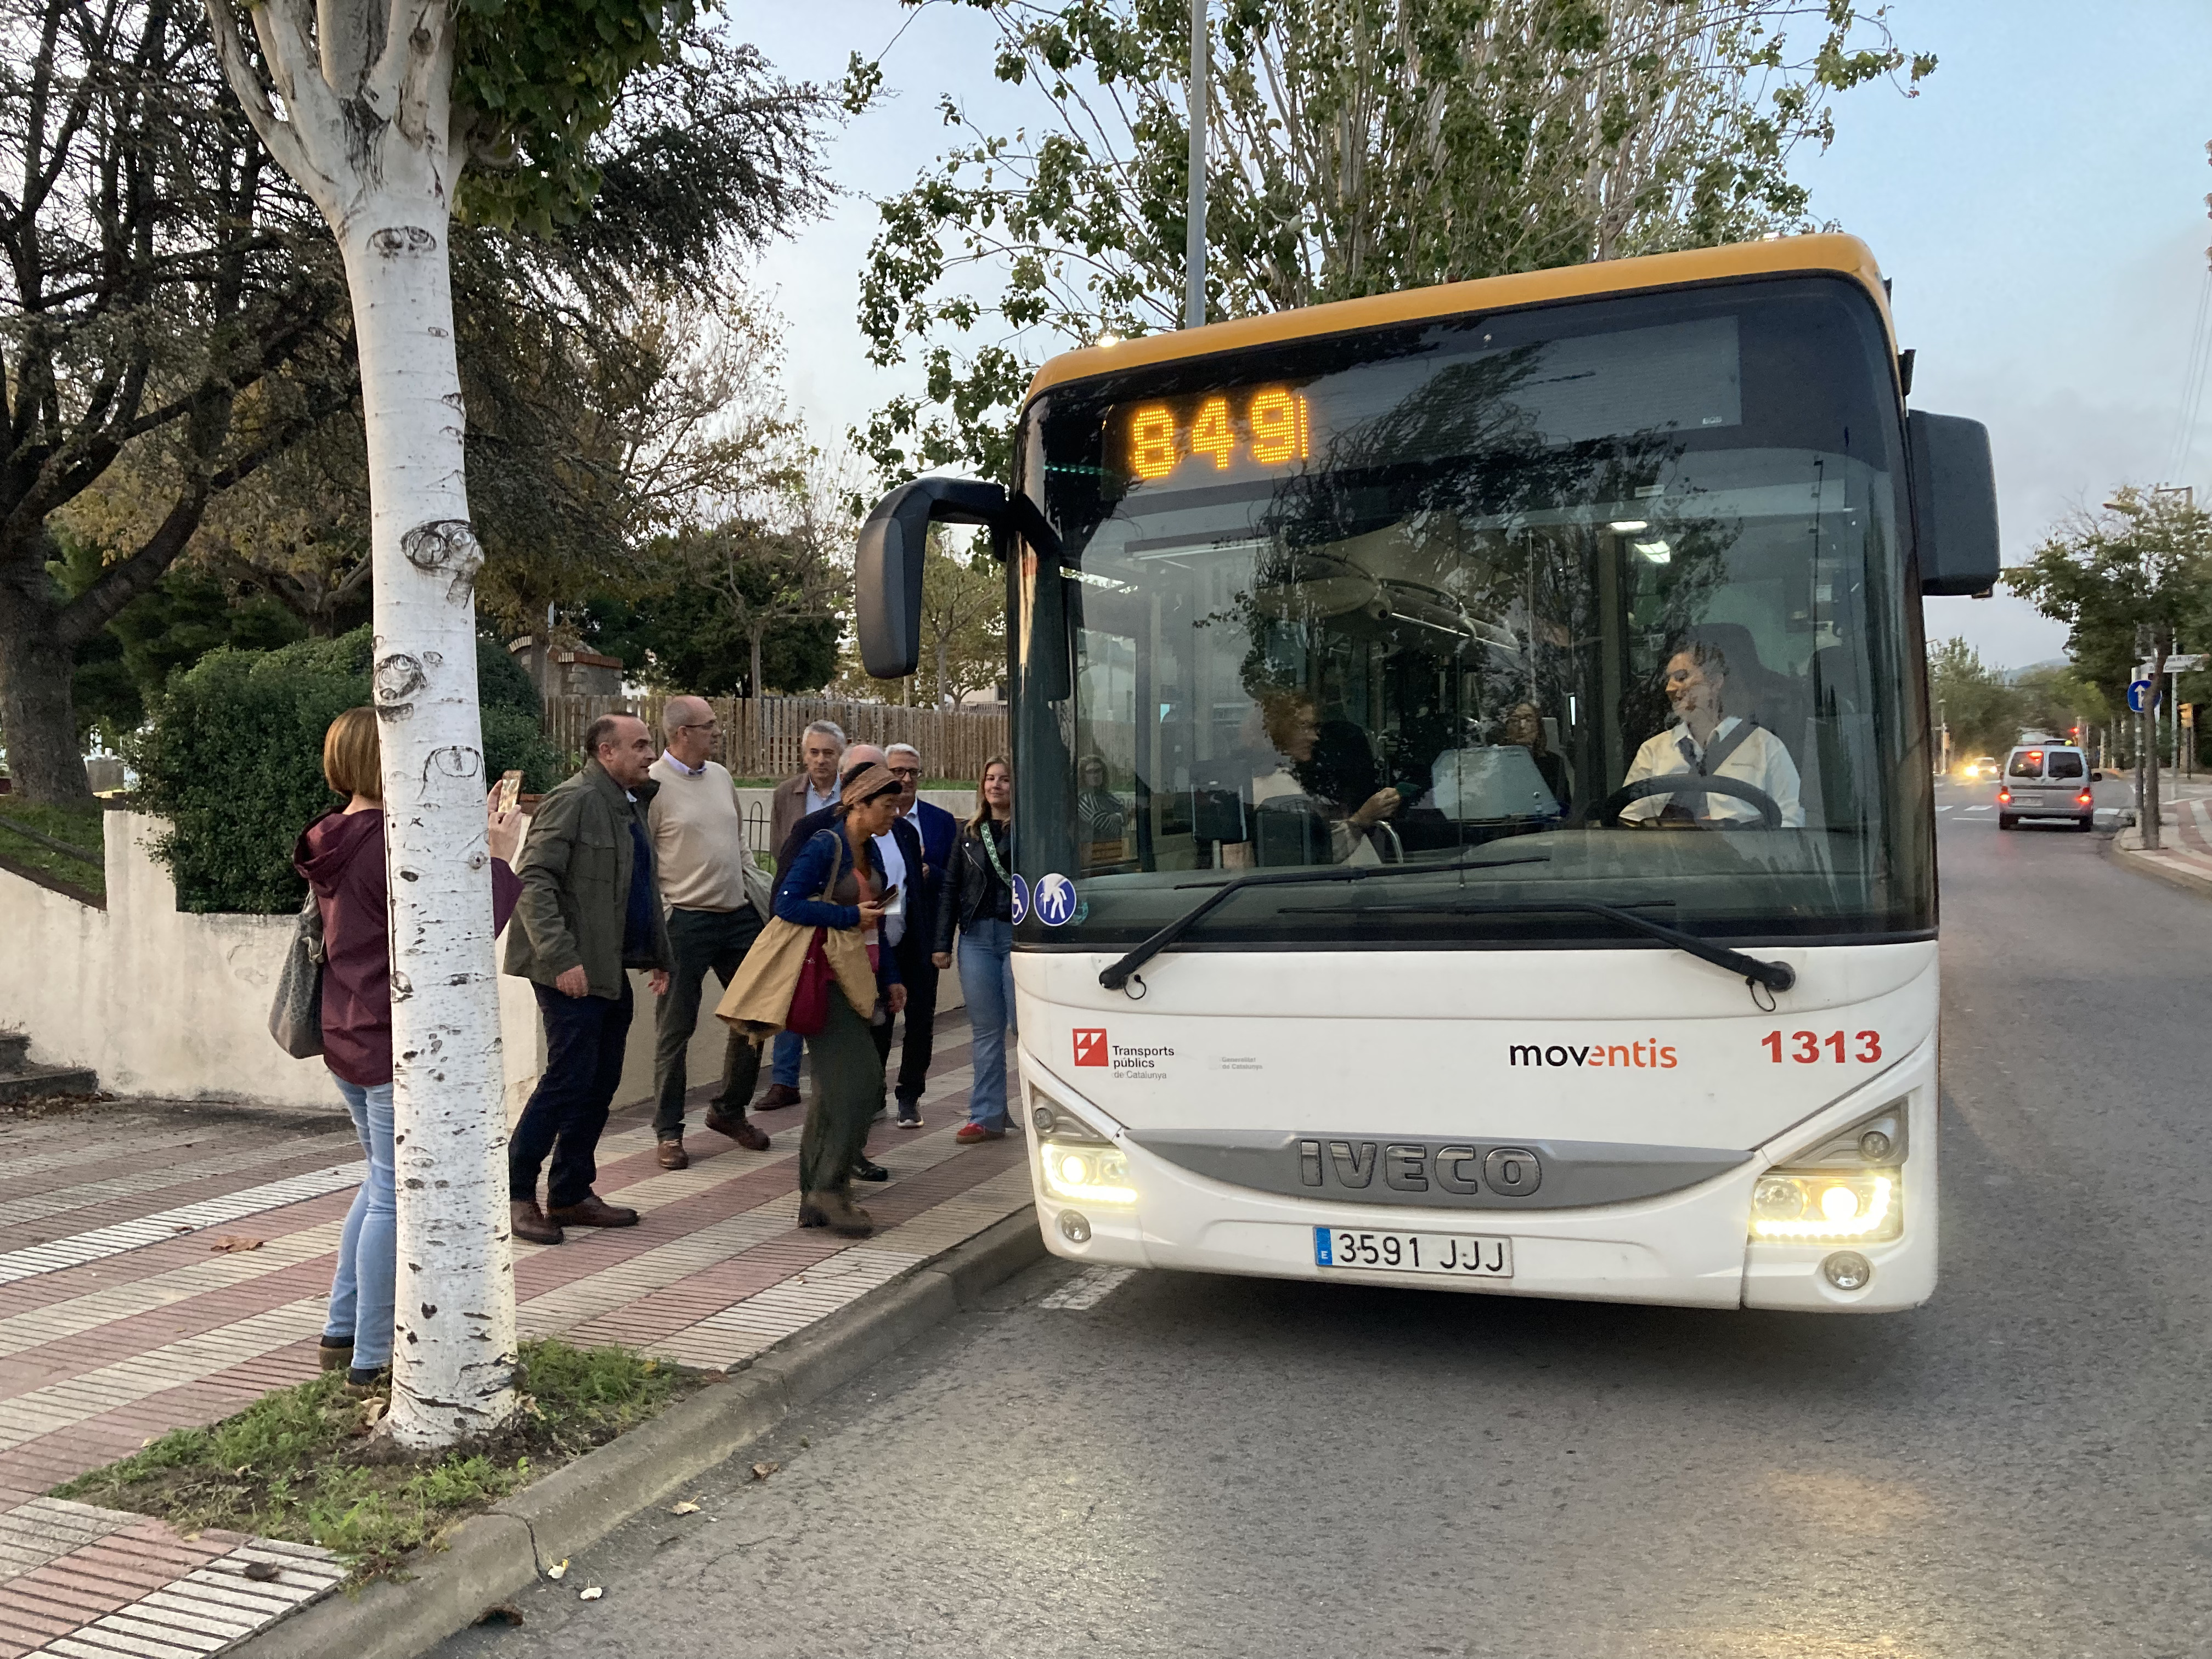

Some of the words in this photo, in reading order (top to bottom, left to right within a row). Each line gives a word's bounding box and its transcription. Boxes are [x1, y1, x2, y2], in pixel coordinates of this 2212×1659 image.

[1112, 1045, 1175, 1058] Transports
[1510, 1037, 1678, 1068] moventis
[1760, 1030, 1883, 1064] 1313
[1113, 1057, 1155, 1070] públics
[1114, 1070, 1125, 1079] de
[1126, 1070, 1167, 1080] Catalunya
[1300, 1140, 1542, 1197] IVECO
[1321, 1250, 1329, 1260] E
[1339, 1233, 1420, 1267] 3591
[1440, 1239, 1503, 1272] JJJ
